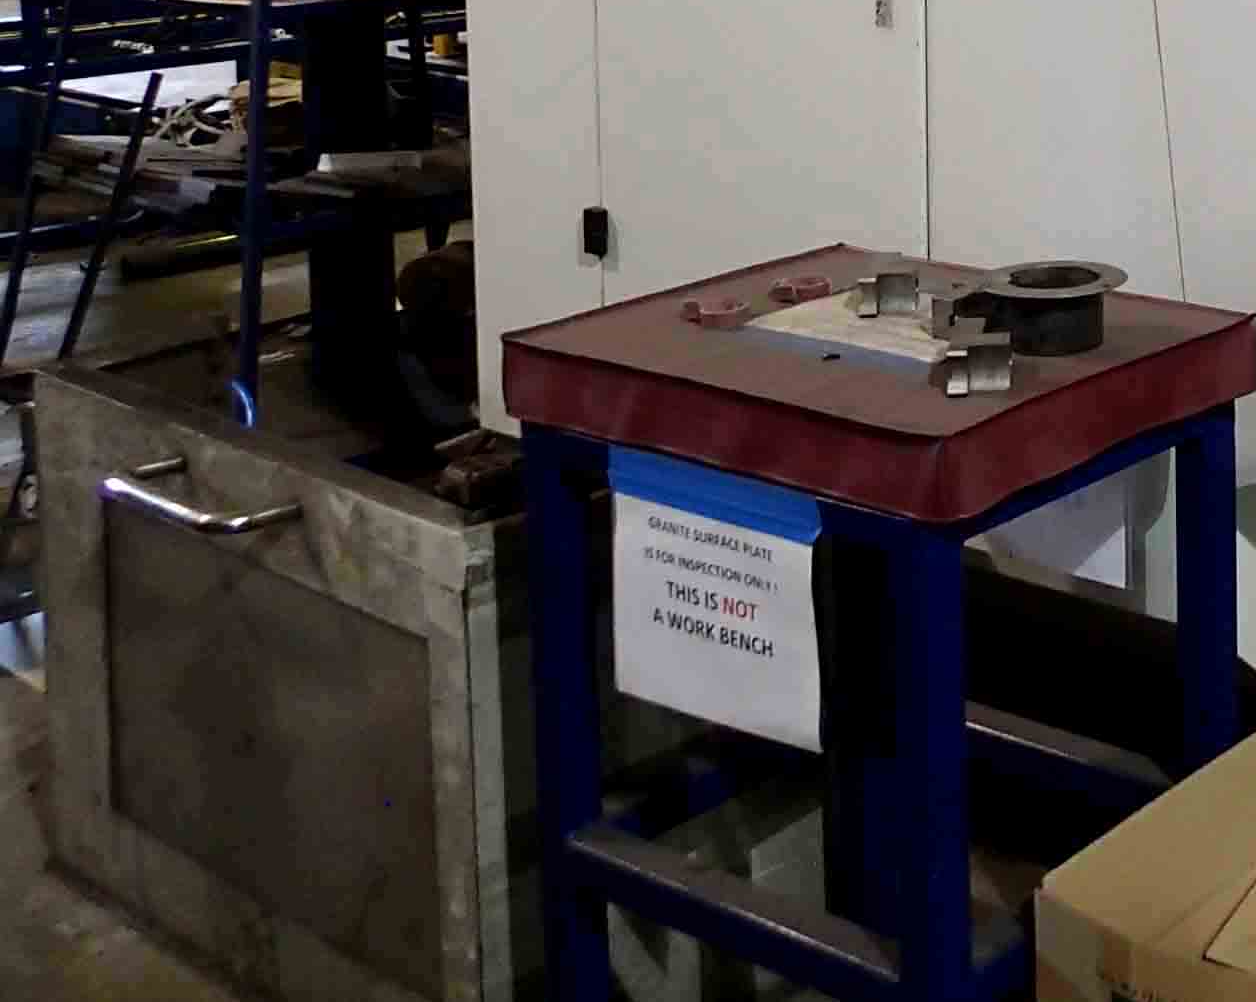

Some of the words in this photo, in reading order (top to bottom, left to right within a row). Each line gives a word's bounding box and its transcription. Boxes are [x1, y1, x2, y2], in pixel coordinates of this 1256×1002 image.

[648, 516, 691, 540] GRANITE
[693, 526, 740, 552] SURFACE
[743, 541, 774, 564] PLATE
[656, 549, 676, 565] FOR
[678, 557, 741, 583] INSPECTION
[666, 580, 701, 606] THIS
[704, 590, 719, 611] IS
[722, 596, 760, 622] NOT
[653, 606, 665, 625] A
[667, 610, 716, 642] WORK
[720, 625, 775, 658] BENCH
